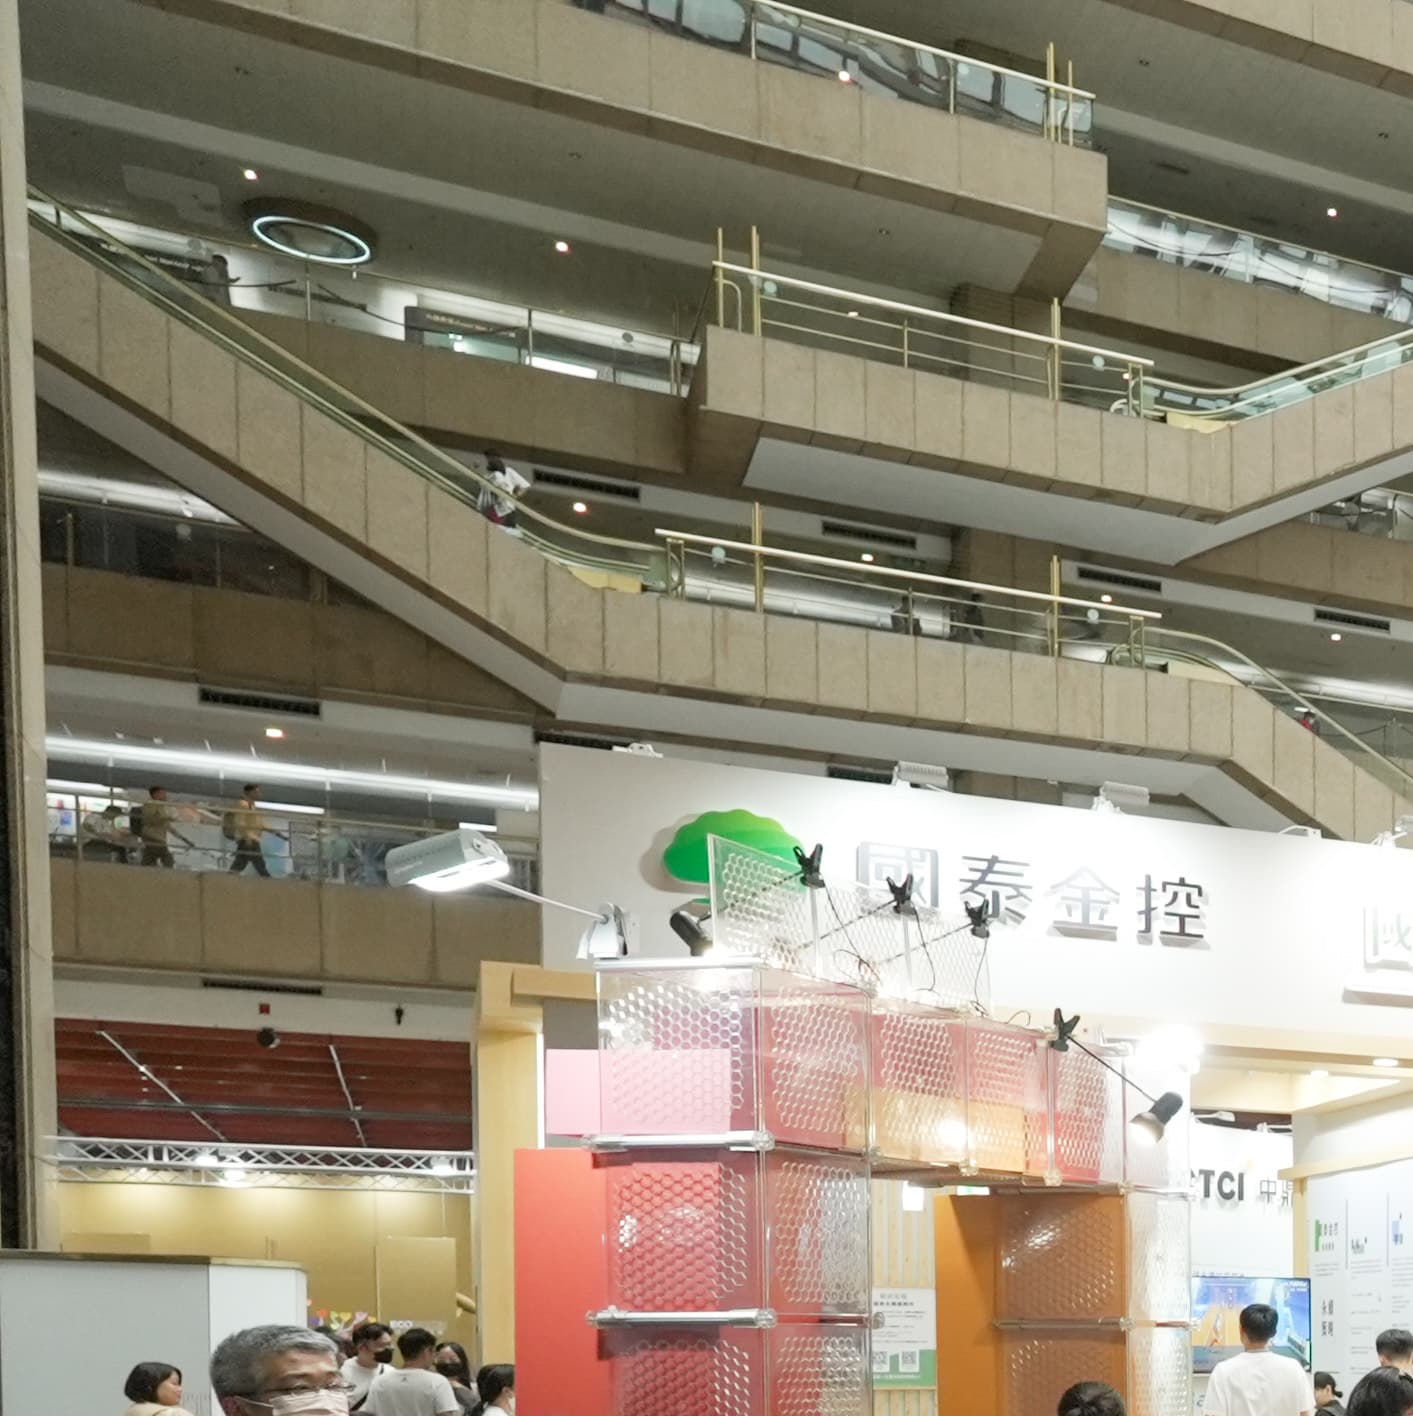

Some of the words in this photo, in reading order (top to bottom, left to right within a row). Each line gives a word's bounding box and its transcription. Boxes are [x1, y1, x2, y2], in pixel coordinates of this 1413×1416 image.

[856, 841, 1205, 940] 國泰金控
[1190, 1169, 1244, 1201] TCI
